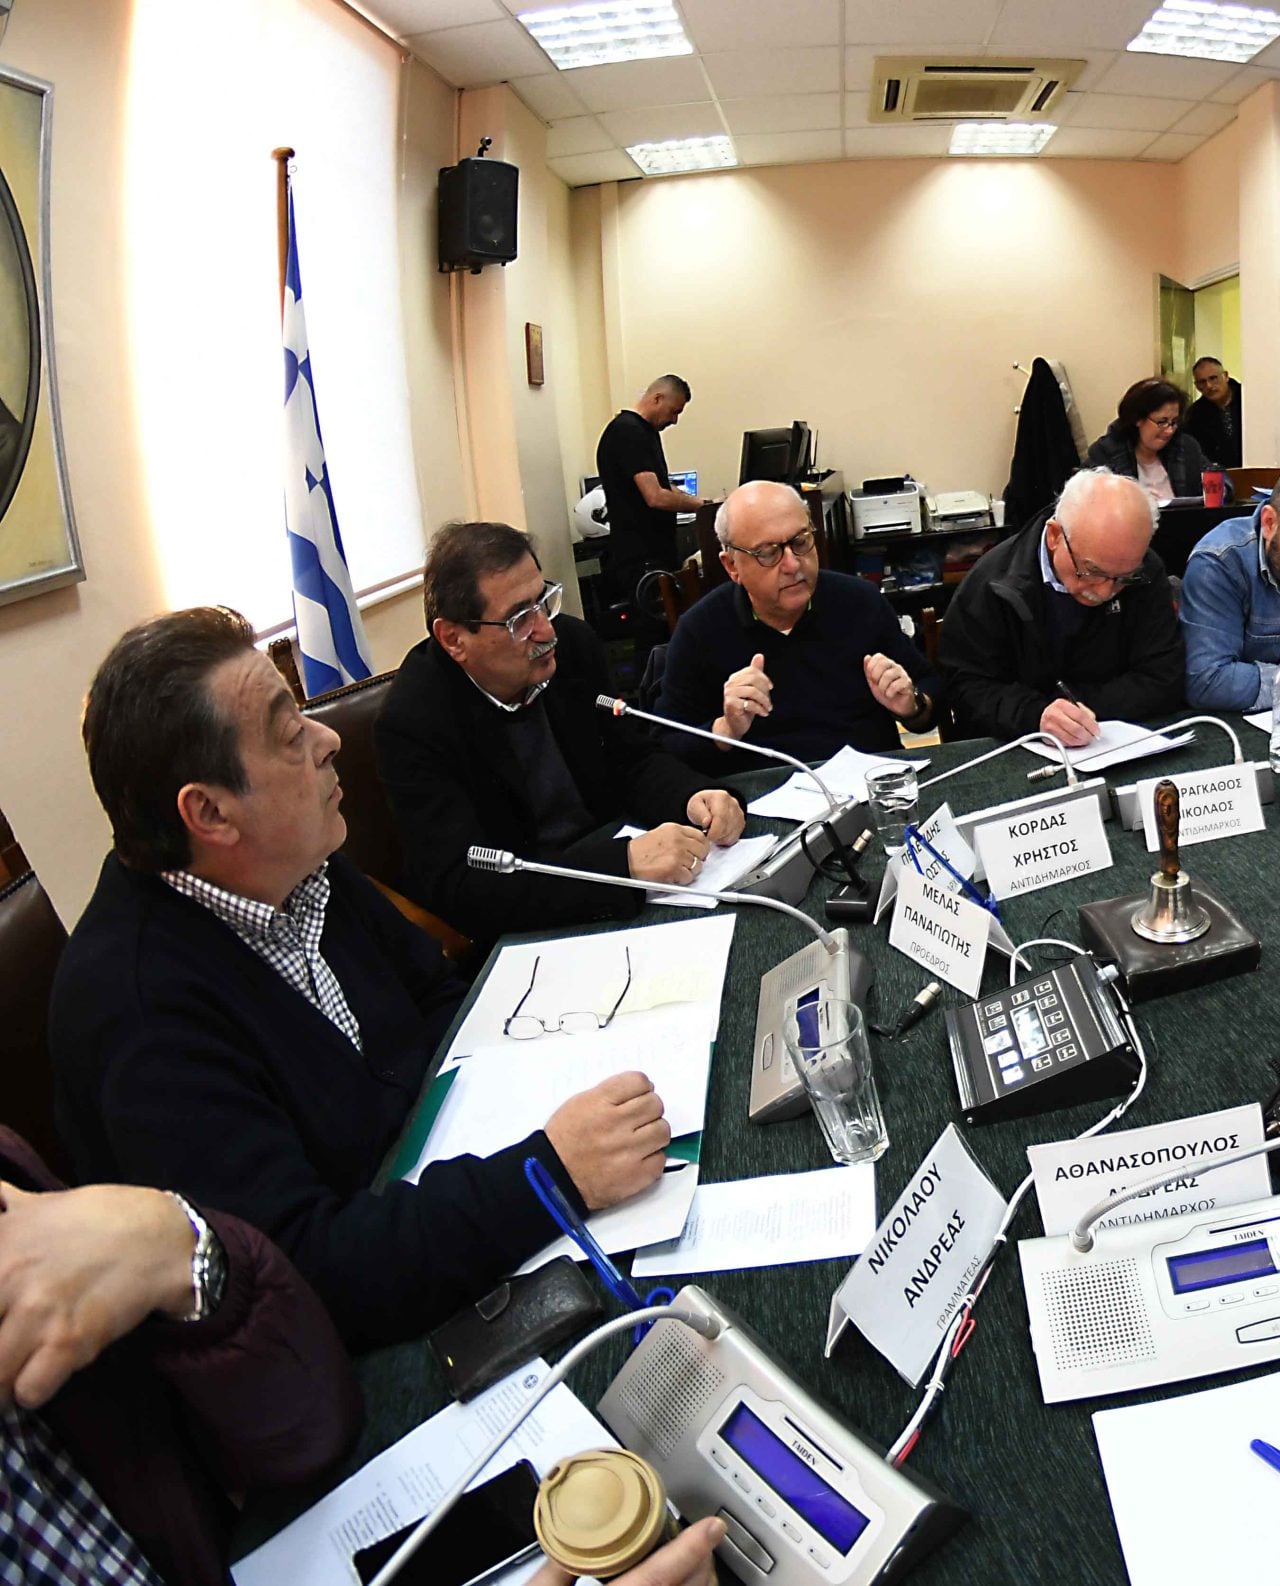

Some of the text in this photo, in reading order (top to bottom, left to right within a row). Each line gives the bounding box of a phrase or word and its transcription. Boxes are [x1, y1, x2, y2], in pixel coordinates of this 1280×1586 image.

[1007, 812, 1068, 839] ΚΟΡΔΑΣ
[1181, 800, 1234, 819] ΙΚΟΛΑΟΣ
[1179, 818, 1242, 838] ΝΤΙΔΗΜΑΡΧΟΣ
[1012, 839, 1079, 868] ΧΡΗΣΤΟΣ
[1009, 860, 1092, 892] ΑΝΤΙΔΗΜΑΡΧΟΣ
[922, 883, 961, 917] ΜΕΛΑΣ
[903, 905, 972, 958] ΠΑΝΑΓΙΩΤΗΣ
[909, 940, 951, 975] ΠΡΟΕΔΡΟΣ
[1054, 1134, 1241, 1181] ΑΘΑΝΑΣΟΠΟΥΛΟΣ
[867, 1162, 943, 1275] ΝΙΚΟΛΑΟΥ
[1233, 1229, 1264, 1241] TAIDEN
[903, 1209, 966, 1308] ΑΝΔΡΕΑΣ
[936, 1254, 982, 1331] ΓΡΑΜΜΑΤΕΑΣ
[791, 1439, 816, 1466] TAIDEN
